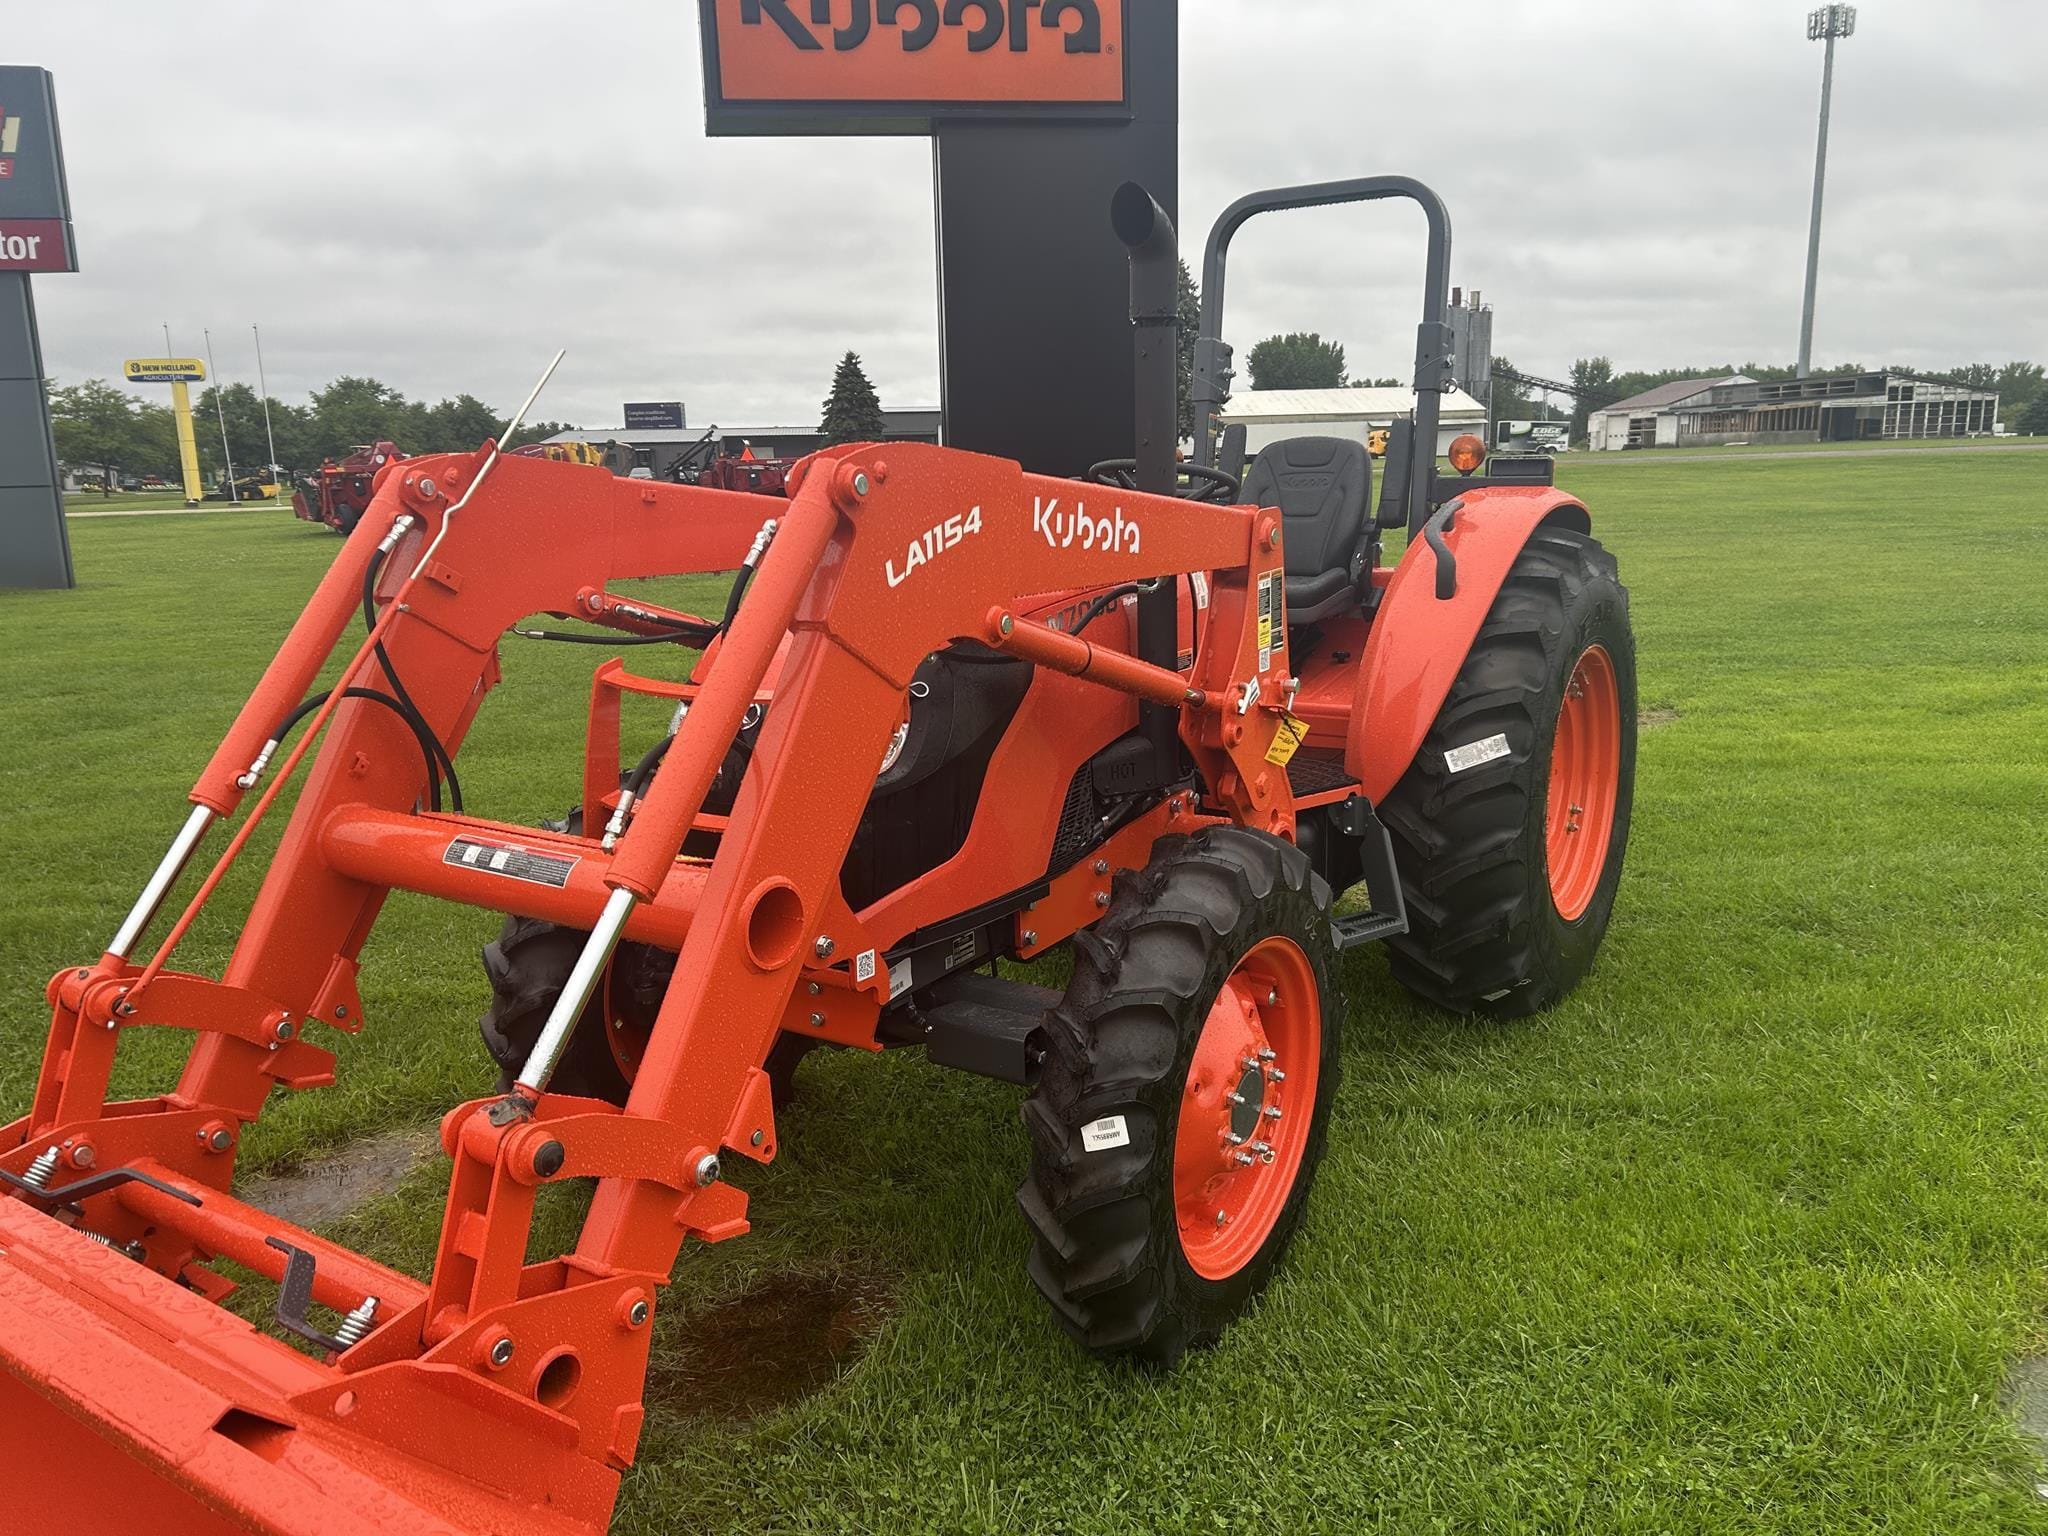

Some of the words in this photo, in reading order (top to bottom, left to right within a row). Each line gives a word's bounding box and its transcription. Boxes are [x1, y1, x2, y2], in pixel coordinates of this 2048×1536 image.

[740, 0, 1101, 53] Kubota
[142, 364, 160, 372] NEW
[160, 364, 196, 372] HOLLAND
[884, 505, 982, 588] LA1154
[1033, 496, 1140, 554] Kubota
[1110, 762, 1136, 780] HOT
